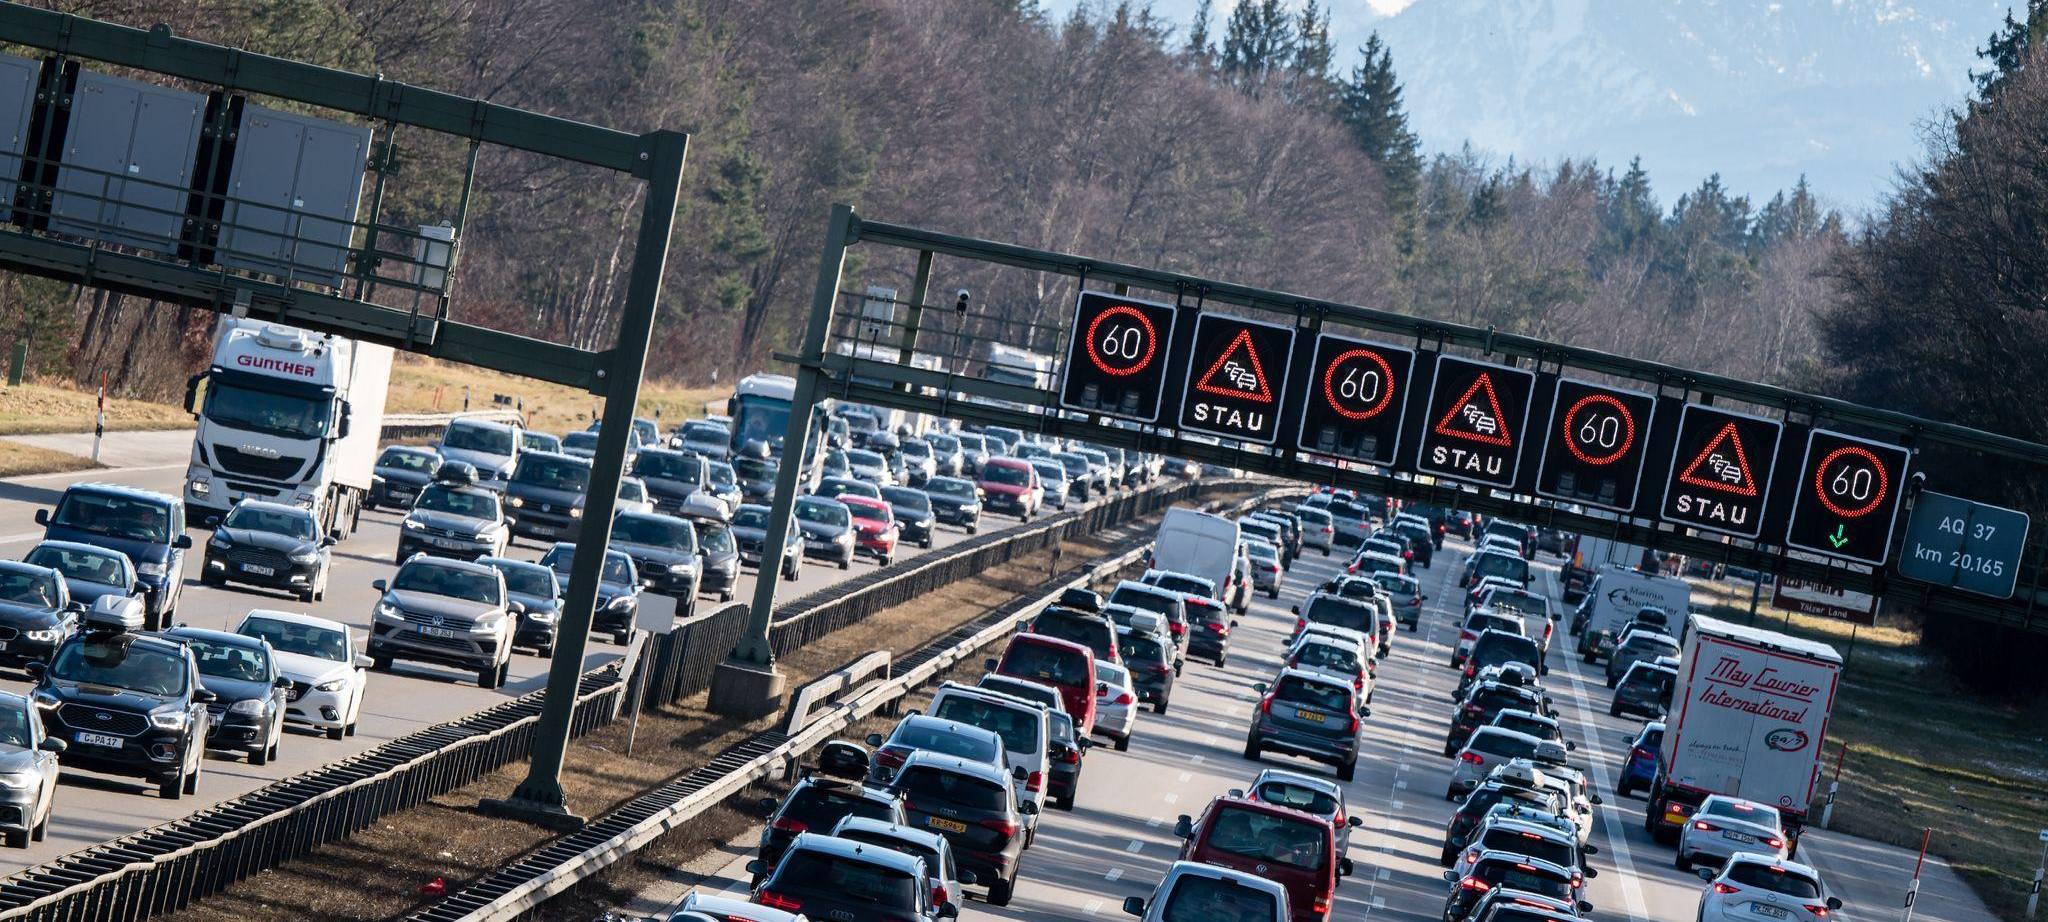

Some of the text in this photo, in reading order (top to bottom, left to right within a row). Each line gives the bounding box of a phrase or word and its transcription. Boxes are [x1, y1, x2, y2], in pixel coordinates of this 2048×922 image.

[1102, 324, 1141, 360] 60
[1340, 367, 1379, 402] 60
[1194, 402, 1264, 432] STAU
[1580, 413, 1619, 448] 60
[1432, 446, 1502, 475] STAU
[1832, 465, 1872, 500] 60
[1676, 495, 1747, 525] STAU
[1938, 516, 1996, 541] AQ 37
[1915, 543, 2004, 576] km 20.165
[1705, 656, 1820, 698] May Courier
[1699, 684, 1809, 724] International
